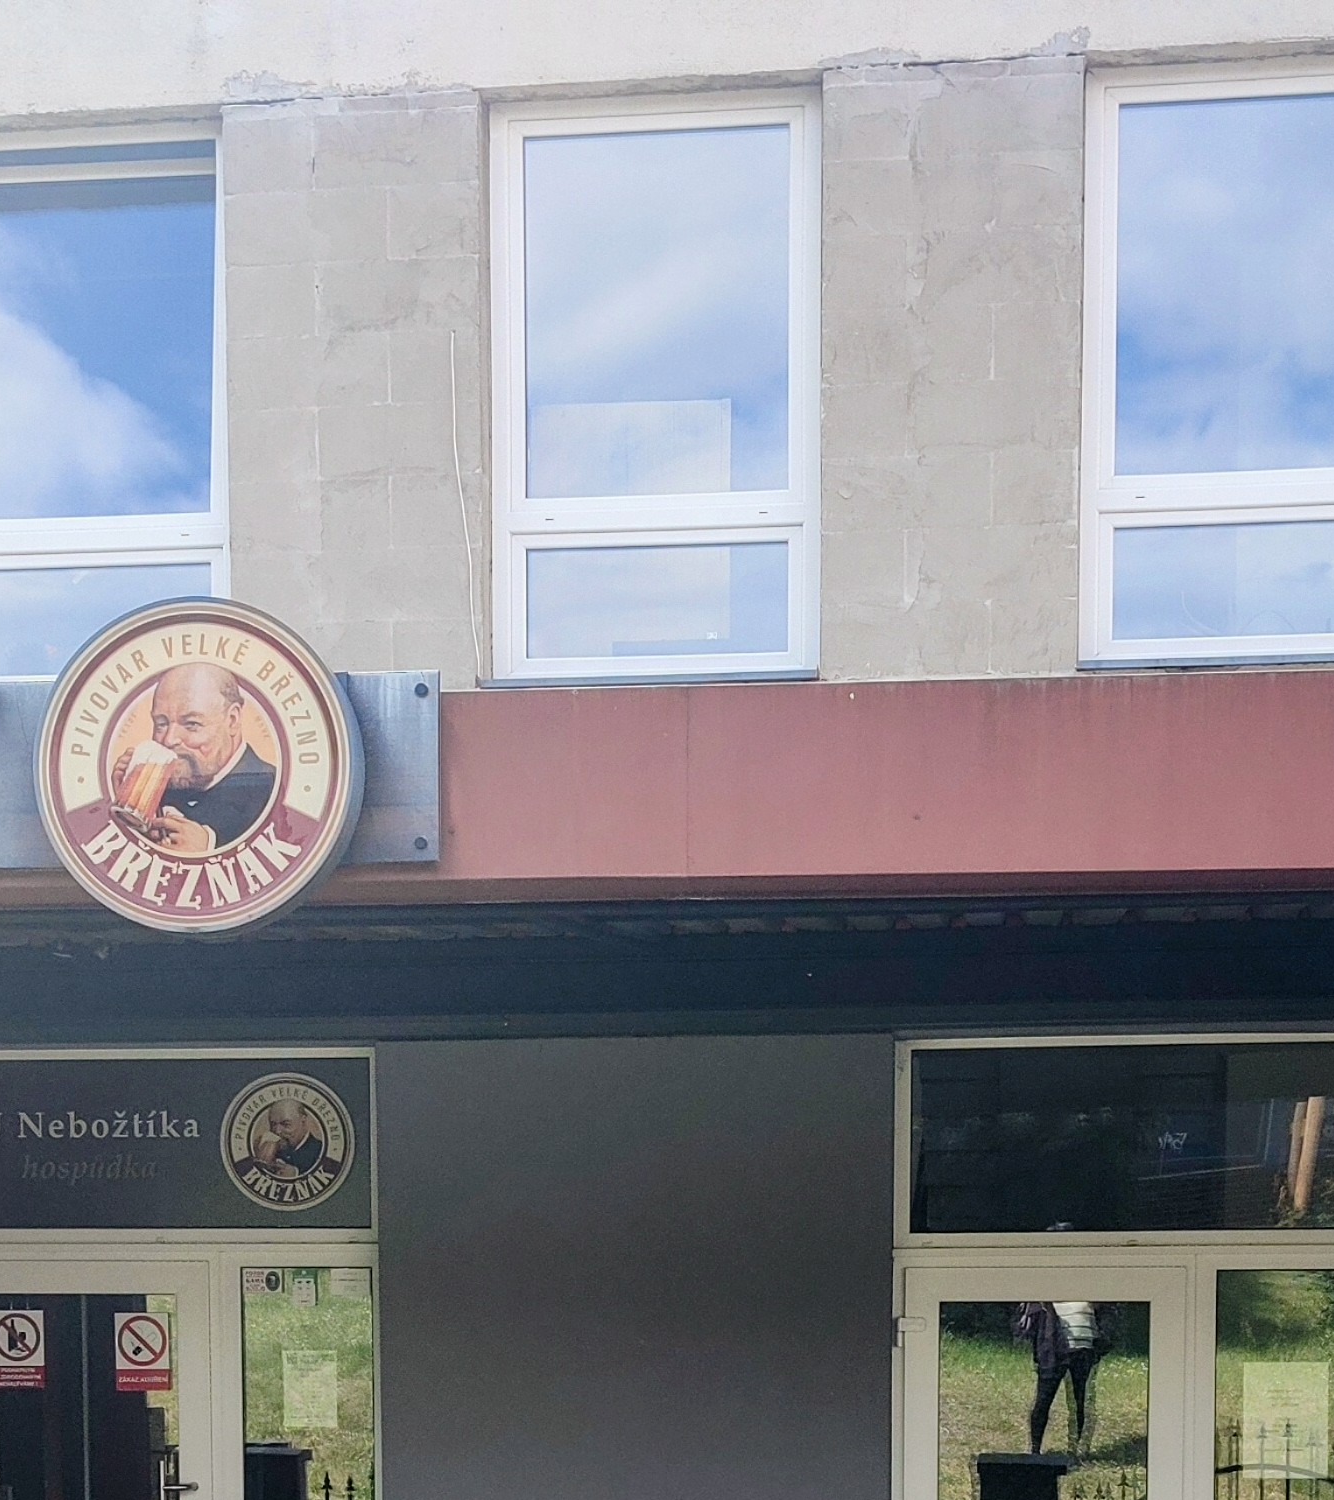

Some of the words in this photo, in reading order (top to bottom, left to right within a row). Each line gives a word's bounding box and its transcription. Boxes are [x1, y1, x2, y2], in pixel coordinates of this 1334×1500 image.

[71, 649, 150, 757] PIVOVAR
[161, 632, 251, 666] VELKÉ
[255, 659, 321, 766] BŘEZNO
[81, 821, 302, 911] BŘEZŇÁK
[17, 1109, 201, 1139] Nebožtíka
[235, 1094, 267, 1141] PIVOVAR
[20, 1151, 157, 1187] hospůdka
